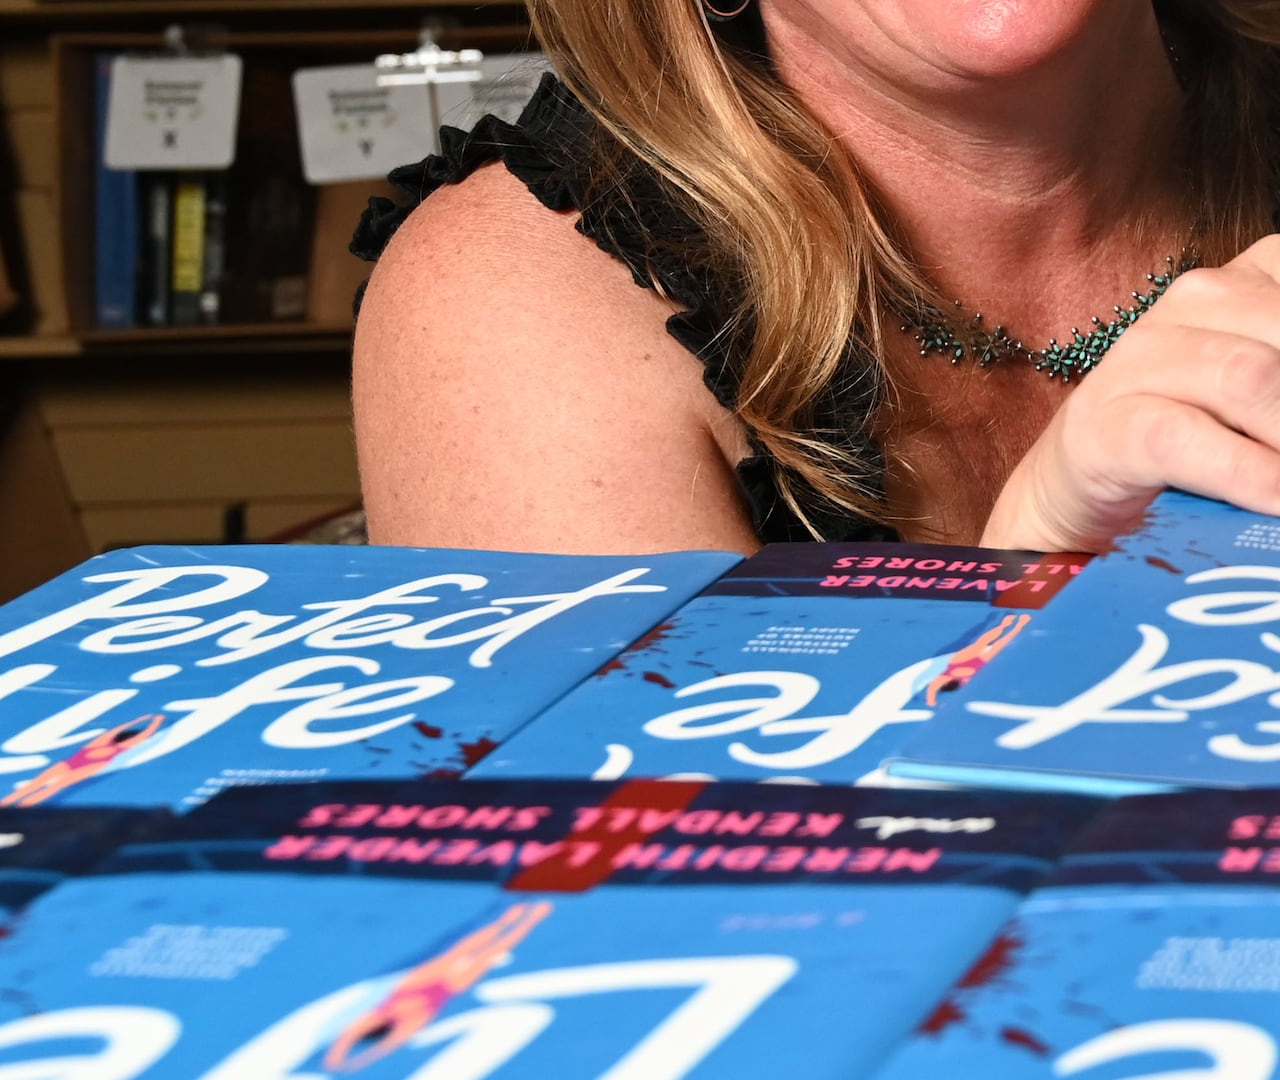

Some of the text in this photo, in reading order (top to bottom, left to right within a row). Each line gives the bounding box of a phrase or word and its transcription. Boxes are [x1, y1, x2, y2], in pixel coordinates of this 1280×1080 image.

[832, 556, 1008, 575] SHORES
[818, 574, 1048, 593] LAVENDER
[0, 564, 668, 669] Perfect
[299, 803, 552, 830] SHORES
[571, 806, 844, 837] KENDALL
[264, 834, 942, 872] MEREDITH LAVENDER
